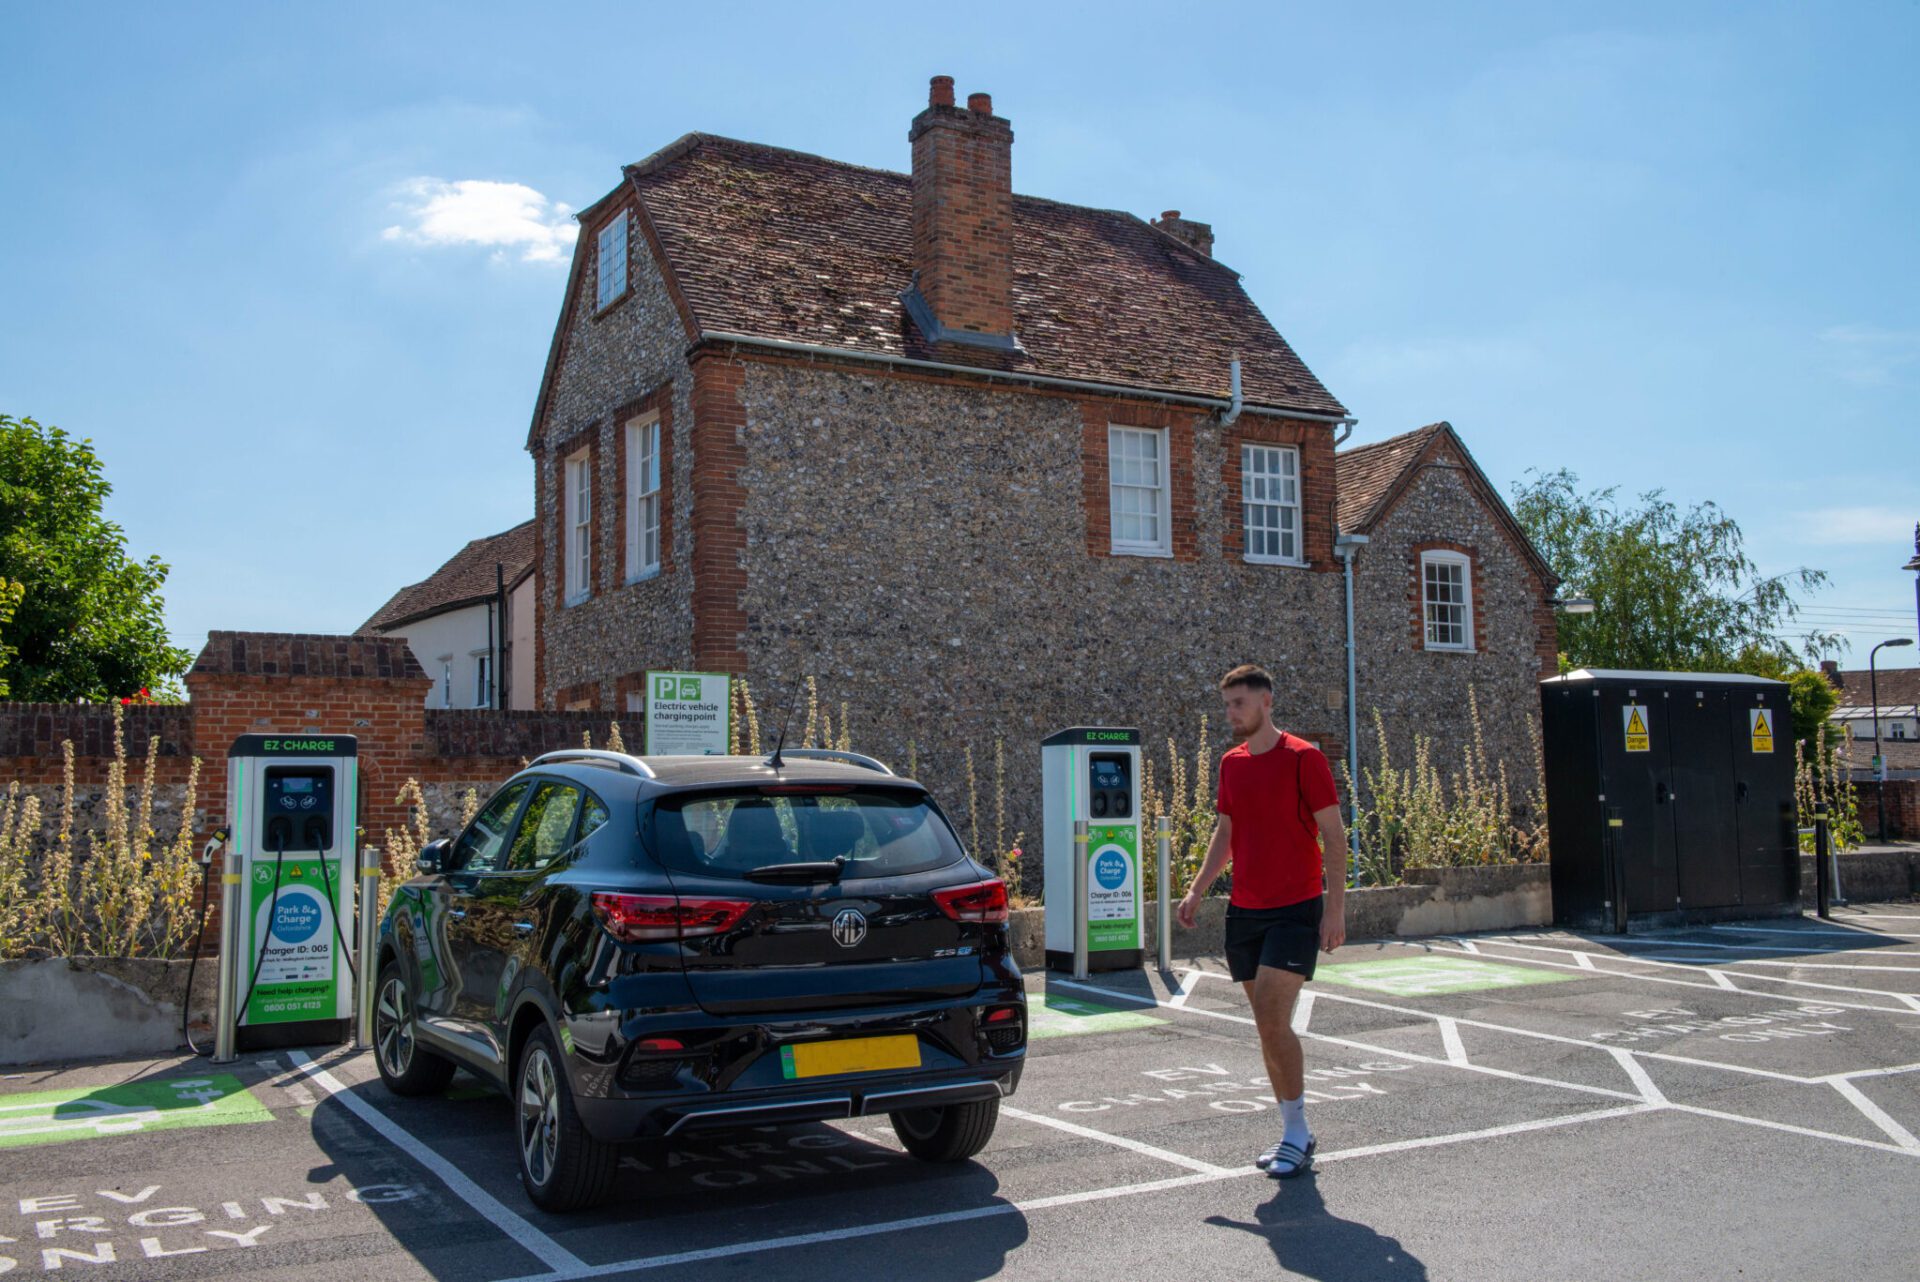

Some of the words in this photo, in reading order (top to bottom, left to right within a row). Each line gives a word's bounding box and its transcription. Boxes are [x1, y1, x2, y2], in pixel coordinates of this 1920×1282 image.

[660, 679, 674, 698] P
[654, 702, 686, 711] Electric
[688, 703, 719, 712] vehicle
[654, 711, 693, 722] charging
[694, 713, 716, 722] point
[1086, 732, 1097, 740] EZ
[1098, 732, 1130, 740] CHARGE
[263, 740, 280, 750] EZ
[283, 740, 335, 751] CHARGE
[1090, 891, 1112, 899] Charger
[277, 905, 299, 915] Park
[277, 914, 312, 925] Charge
[297, 945, 309, 954] ID:
[311, 944, 328, 953] 005
[1621, 1007, 1698, 1020] EV
[1719, 1022, 1854, 1042] ONLY
[1141, 1063, 1230, 1082] EV
[18, 1184, 162, 1215] EV
[0, 1184, 423, 1244] RGING
